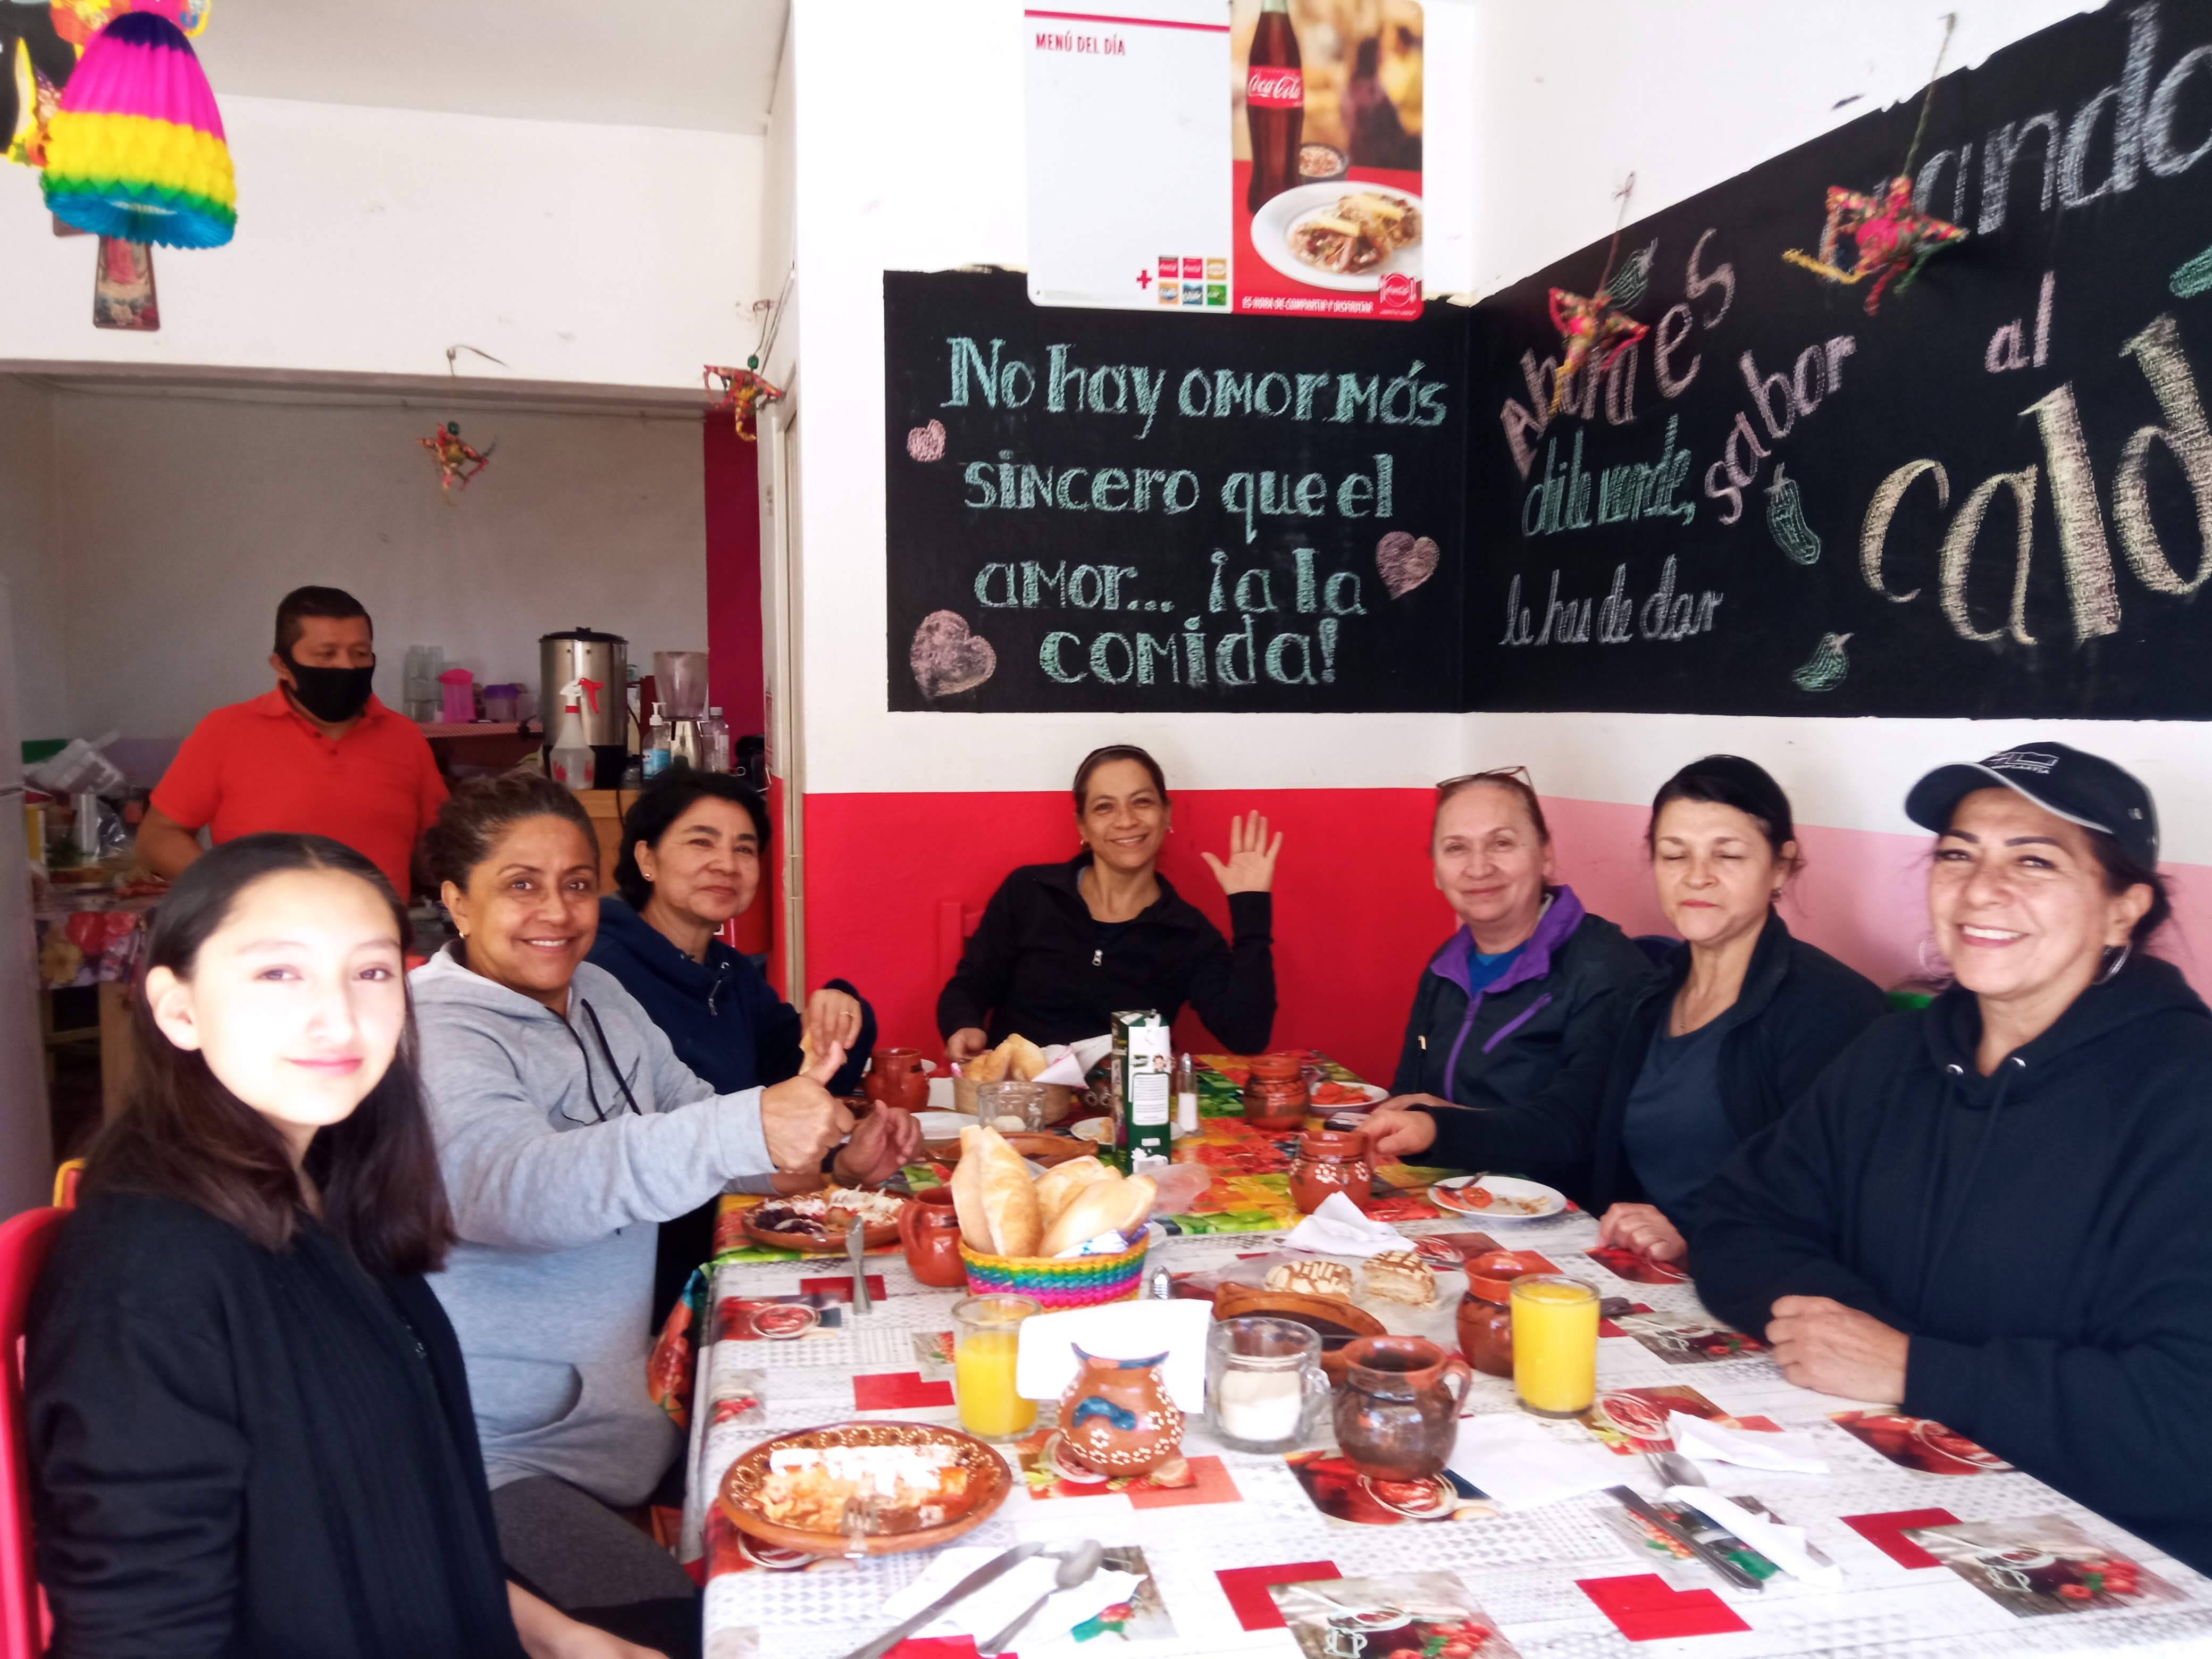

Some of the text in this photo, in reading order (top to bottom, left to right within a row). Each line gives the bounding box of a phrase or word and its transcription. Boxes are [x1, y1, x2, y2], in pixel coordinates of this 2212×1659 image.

[1036, 30, 1125, 56] MENÚ DEL DÍA
[1655, 228, 1736, 399] es
[940, 337, 1035, 409] No
[1045, 343, 1166, 440] hay
[1705, 270, 2056, 525] sabor al
[963, 449, 1394, 544] sincero que el
[1292, 548, 1369, 616] la
[1498, 574, 1535, 647] le
[1639, 554, 1724, 642] dar
[1039, 614, 1339, 688] comida!
